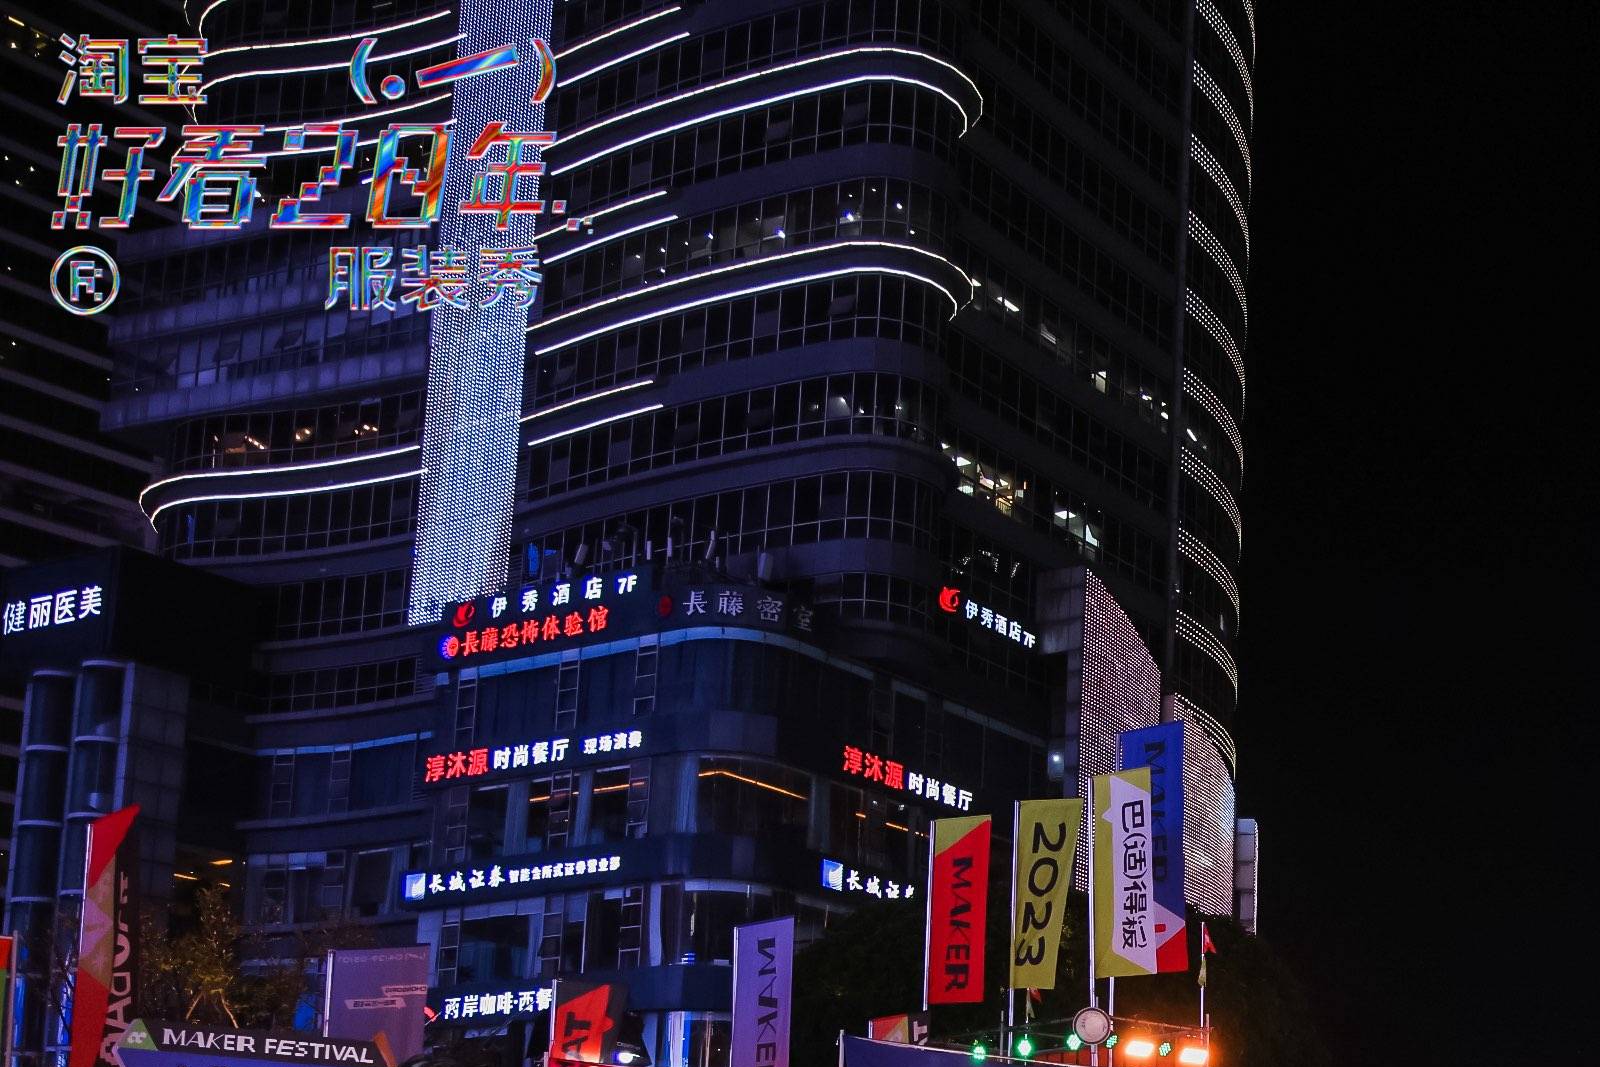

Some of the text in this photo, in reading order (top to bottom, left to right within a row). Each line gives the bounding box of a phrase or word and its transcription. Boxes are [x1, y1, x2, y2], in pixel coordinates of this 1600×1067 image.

[3, 585, 103, 635] 健丽医美
[944, 857, 973, 993] MAKER
[1016, 822, 1066, 966] 2023
[161, 1027, 375, 1065] MAKER FESTIVAL
